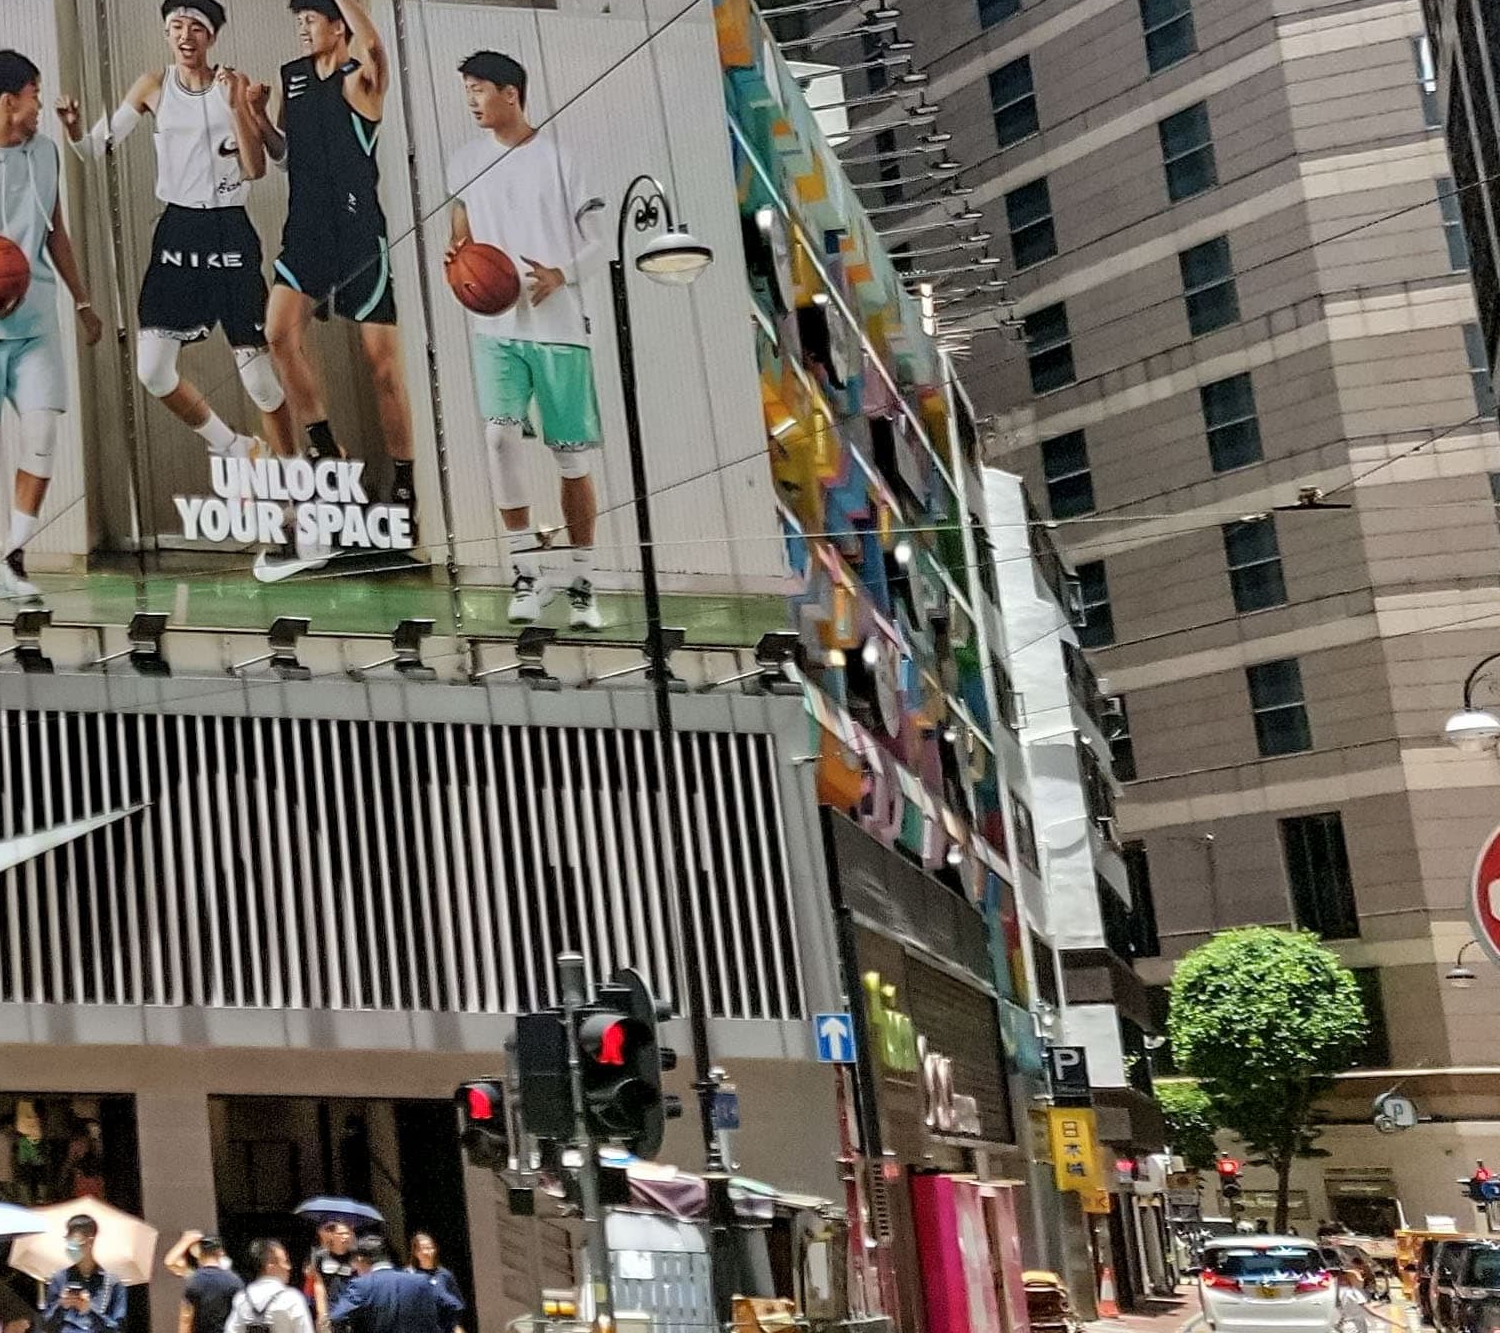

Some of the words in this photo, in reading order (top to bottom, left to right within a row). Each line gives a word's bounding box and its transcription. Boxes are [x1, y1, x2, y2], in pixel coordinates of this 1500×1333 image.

[161, 250, 243, 268] NIKE
[209, 455, 368, 505] UNLOCK
[174, 496, 287, 544] YOUR
[296, 503, 412, 549] SPACE
[1053, 1049, 1080, 1080] P
